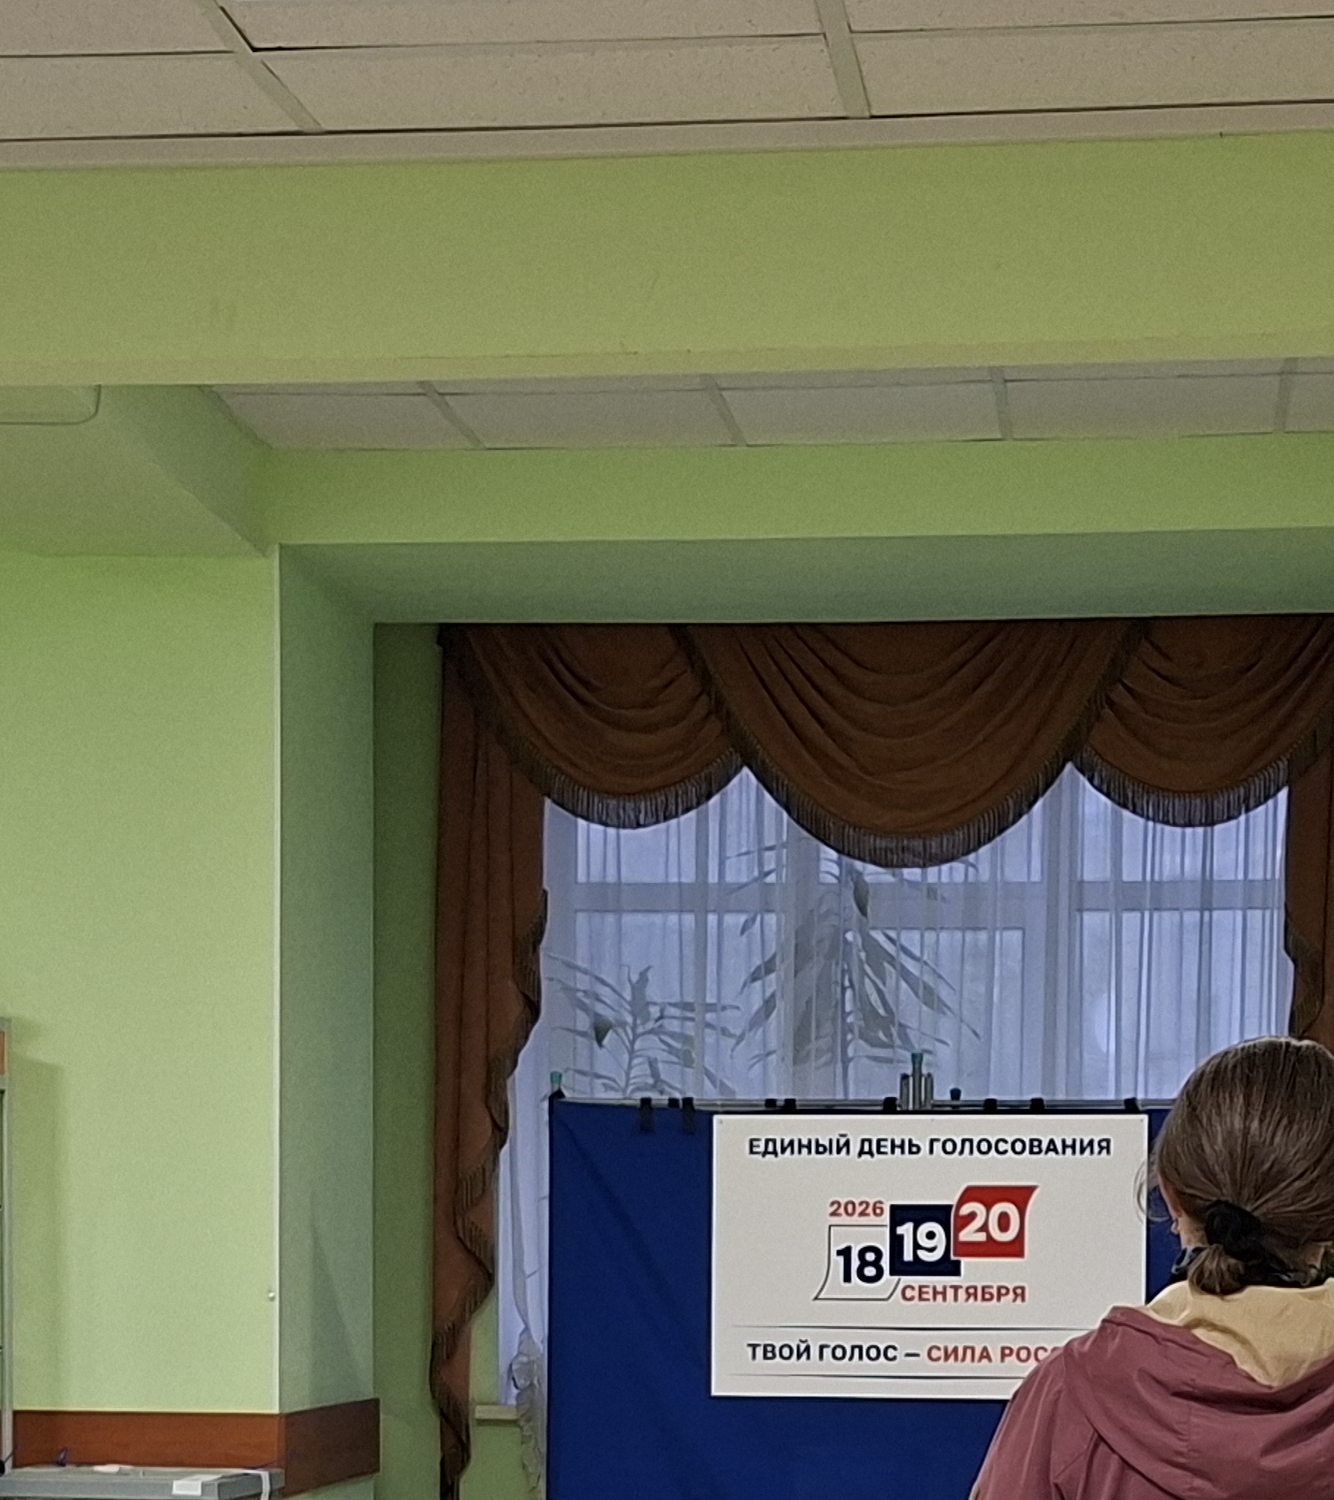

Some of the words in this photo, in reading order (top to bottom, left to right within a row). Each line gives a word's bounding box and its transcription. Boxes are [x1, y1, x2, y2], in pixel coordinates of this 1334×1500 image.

[748, 1133, 851, 1158] ЕДИНЫЙ
[857, 1137, 922, 1158] ДЕНЬ
[928, 1137, 1112, 1156] ГОЛОСОВАНИЯ
[828, 1200, 885, 1218] 2026
[836, 1245, 884, 1284] 18
[895, 1220, 947, 1262] 19
[958, 1202, 1020, 1242] 20
[900, 1284, 1026, 1303] СЕНТЯБРЯ
[747, 1339, 811, 1361] ТВОЙ
[818, 1343, 898, 1362] ГОЛОС
[926, 1345, 993, 1363] СИЛА
[1000, 1345, 1064, 1363] РОС
